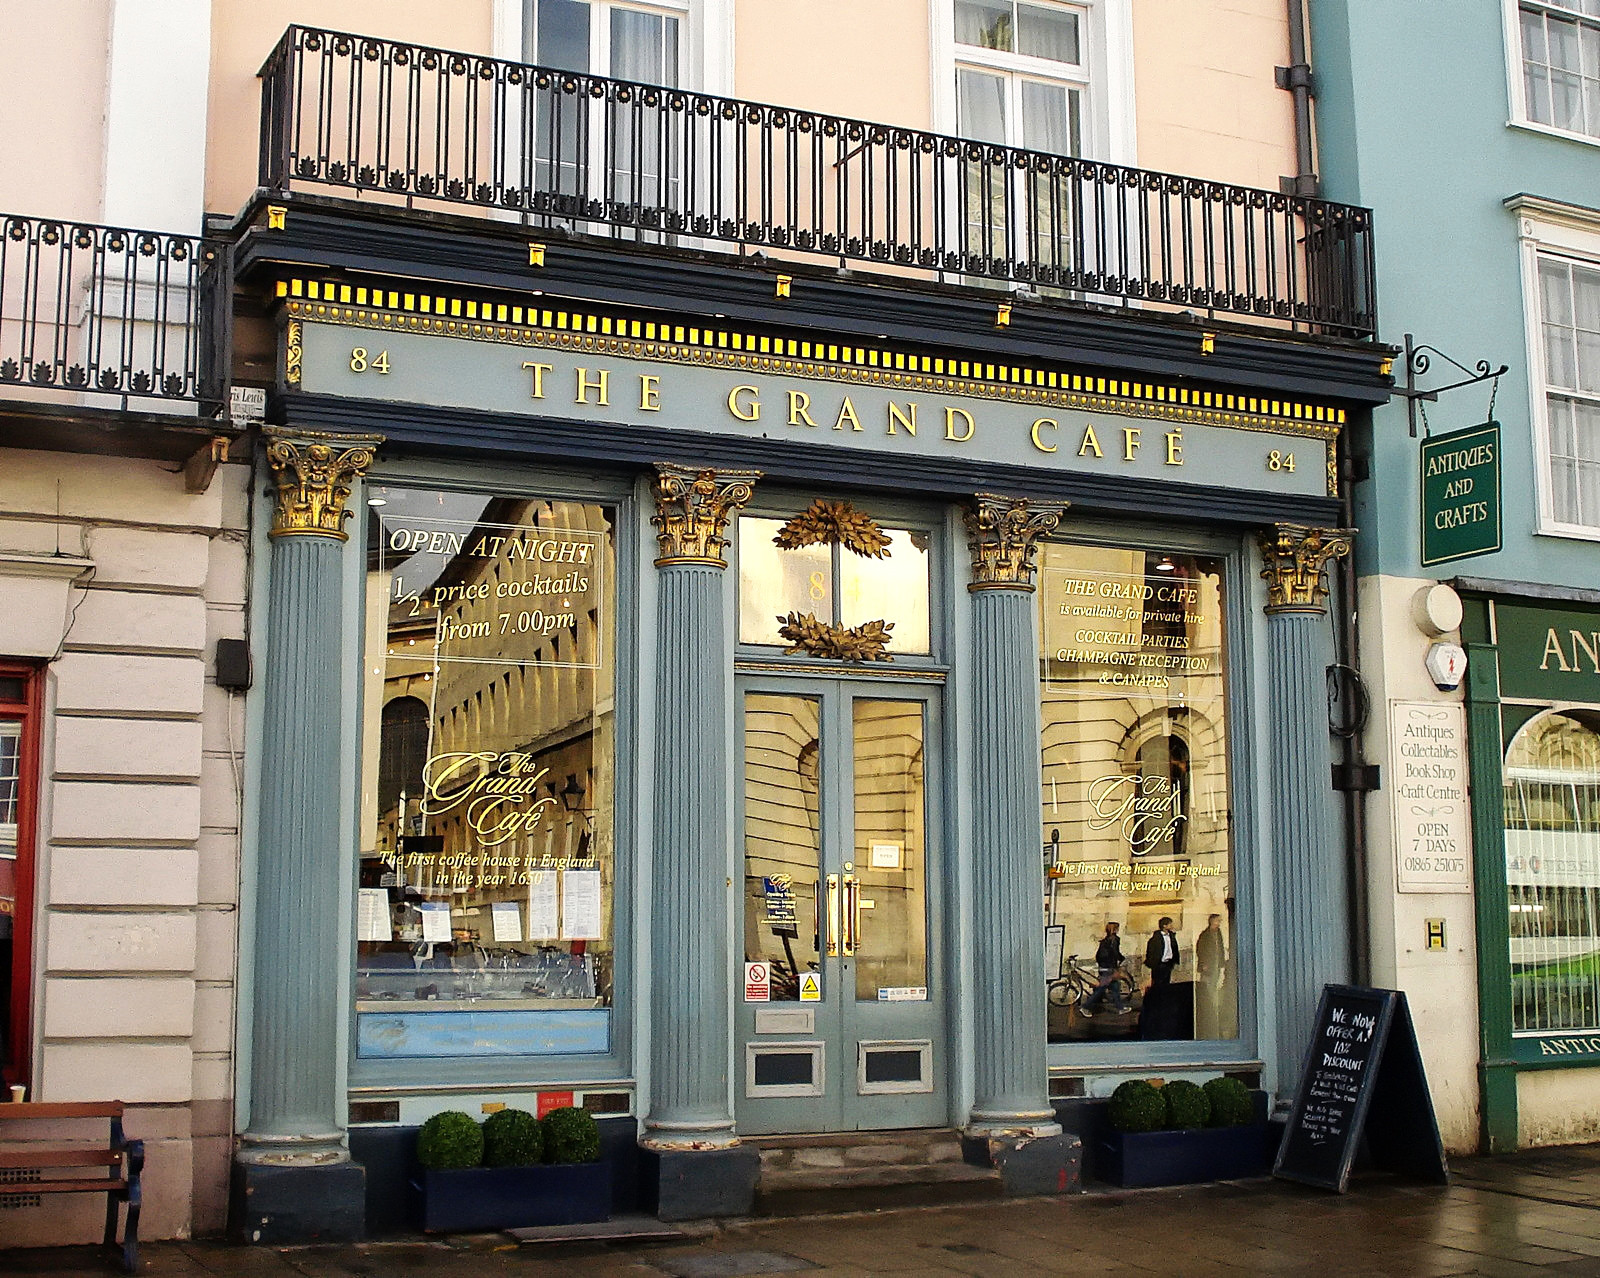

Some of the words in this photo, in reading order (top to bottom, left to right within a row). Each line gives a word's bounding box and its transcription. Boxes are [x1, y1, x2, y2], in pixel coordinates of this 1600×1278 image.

[350, 347, 391, 374] 84
[523, 361, 661, 412] THE
[727, 383, 976, 443] GRAND
[1031, 417, 1185, 466] CAFÉ
[1269, 450, 1296, 474] 84
[1427, 443, 1493, 477] ANTIQUES
[1443, 478, 1474, 499] AND
[1435, 501, 1488, 530] CRAFTS
[390, 528, 466, 555] OPEN
[470, 536, 506, 558] AT
[511, 539, 595, 564] NIGHT
[432, 579, 490, 608] price
[497, 571, 589, 598] cocktails
[1064, 580, 1096, 596] THE
[1100, 582, 1153, 600] GRAND
[1158, 587, 1198, 604] CAFE
[1060, 604, 1070, 615] is
[1073, 604, 1123, 618] available
[1123, 607, 1141, 621] for
[1143, 610, 1181, 624] private
[1184, 611, 1205, 624] hire
[438, 615, 491, 644] from
[498, 609, 576, 636] 7.00pm
[1075, 629, 1139, 646] COCKTAIL
[1141, 634, 1190, 649] PARTIES
[1057, 649, 1137, 666] CHAMPAGNE
[1139, 654, 1209, 670] RECEPTION
[1539, 628, 1600, 674] AN
[1099, 672, 1111, 685] &
[1404, 723, 1454, 743] Antiques
[1401, 743, 1459, 759] Collectables
[498, 752, 536, 774] The
[1406, 763, 1431, 778] Book
[1432, 765, 1456, 781] Shop
[420, 751, 550, 816] Grand
[1143, 775, 1171, 795] The
[1401, 784, 1424, 799] Craft
[1426, 785, 1460, 800] Centre
[1088, 775, 1181, 830] Grand
[467, 795, 558, 846] Café
[1417, 823, 1449, 837] OPEN
[1122, 812, 1187, 855] Café
[1412, 840, 1420, 852] 7
[1426, 840, 1456, 852] DAYS
[380, 850, 404, 865] The
[406, 851, 435, 867] first
[439, 852, 478, 869] coffee
[483, 853, 520, 867] house
[524, 854, 538, 867] in
[541, 854, 596, 870] England
[1055, 861, 1074, 874] The
[1075, 862, 1099, 877] first
[1100, 862, 1132, 878] coffee
[1134, 862, 1165, 876] house
[1166, 863, 1177, 876] in
[1178, 864, 1221, 879] England
[1405, 857, 1431, 871] 01865
[436, 871, 450, 885] in
[454, 871, 476, 885] the
[477, 874, 507, 888] year
[511, 871, 543, 886] 1650
[1100, 879, 1110, 891] in
[1111, 879, 1128, 891] the
[1129, 881, 1153, 894] year
[1157, 880, 1182, 892] 1650
[1428, 922, 1444, 948] H
[1332, 1008, 1347, 1024] WE
[1326, 1025, 1355, 1040] OFFER
[1334, 1041, 1352, 1054] 10%
[1322, 1053, 1364, 1071] DISCOUNT
